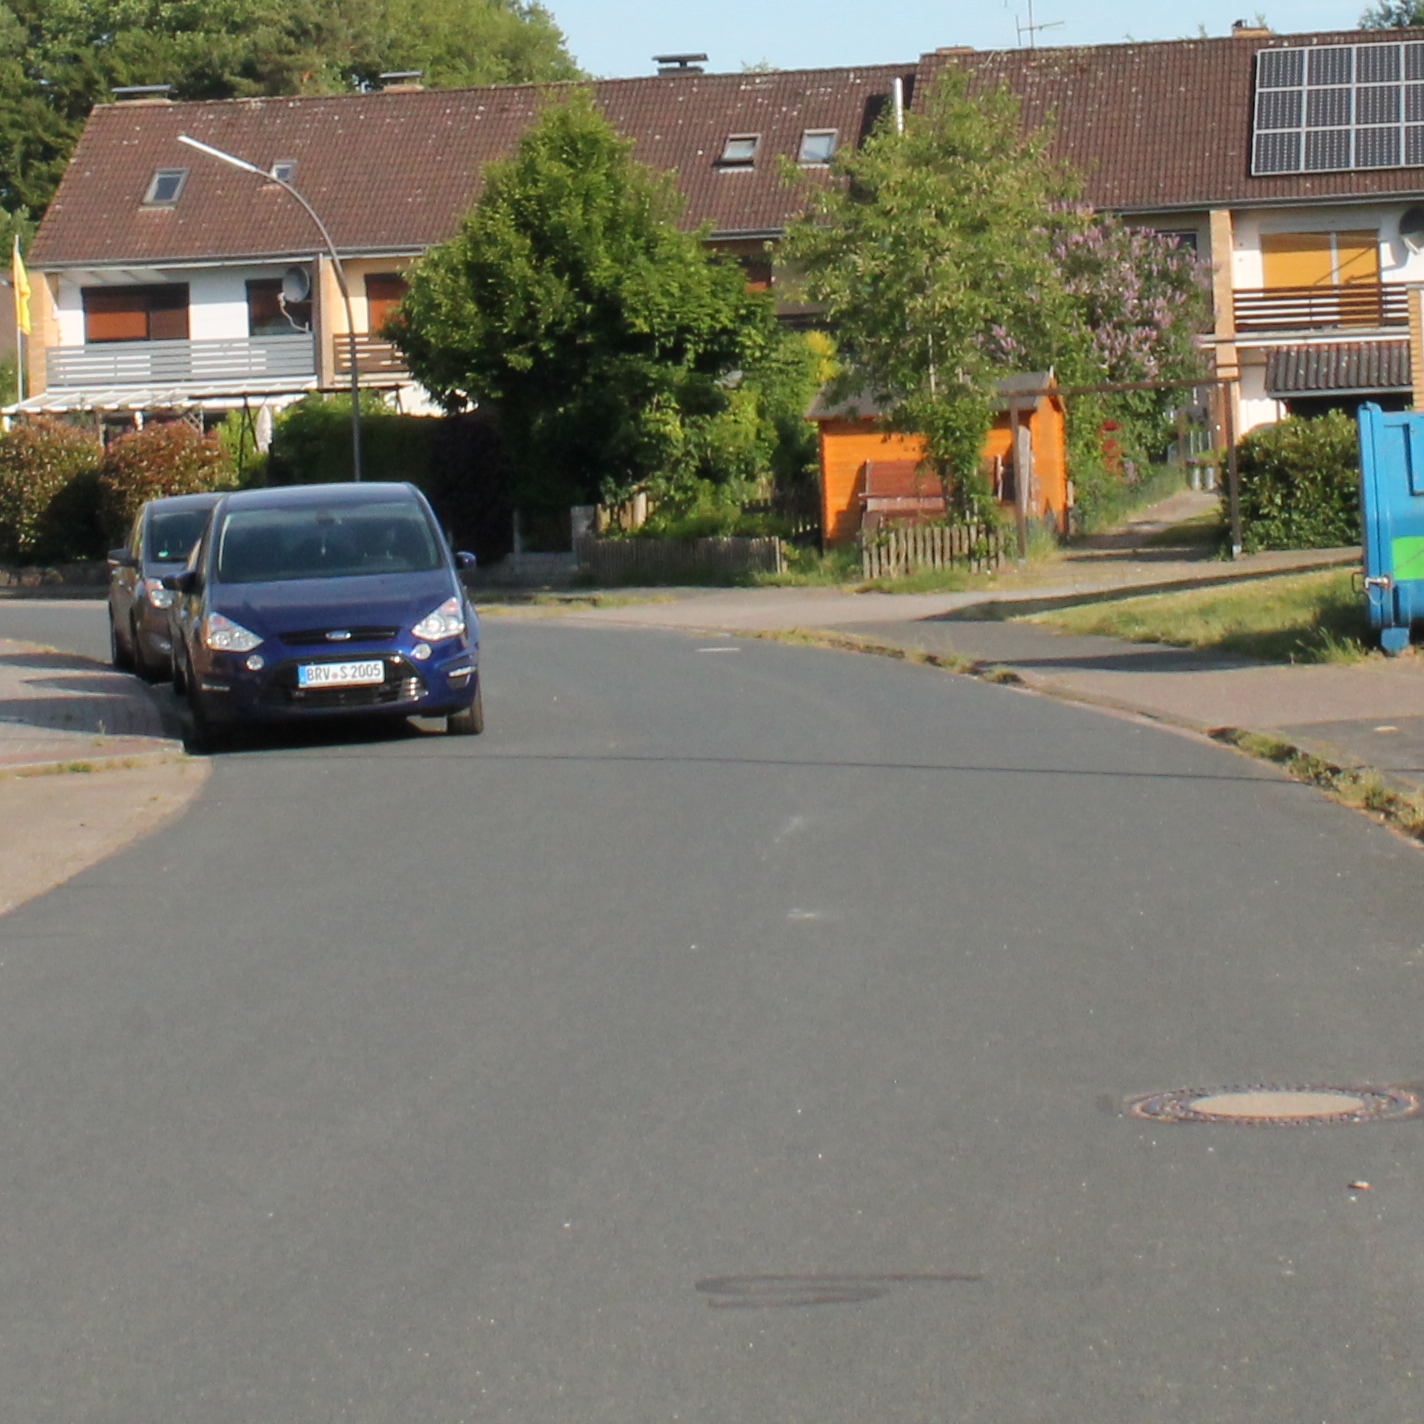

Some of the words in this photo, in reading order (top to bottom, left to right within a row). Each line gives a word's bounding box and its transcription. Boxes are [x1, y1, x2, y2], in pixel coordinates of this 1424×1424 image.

[306, 666, 331, 681] BRV
[339, 665, 348, 679] S
[350, 663, 381, 678] 2005
